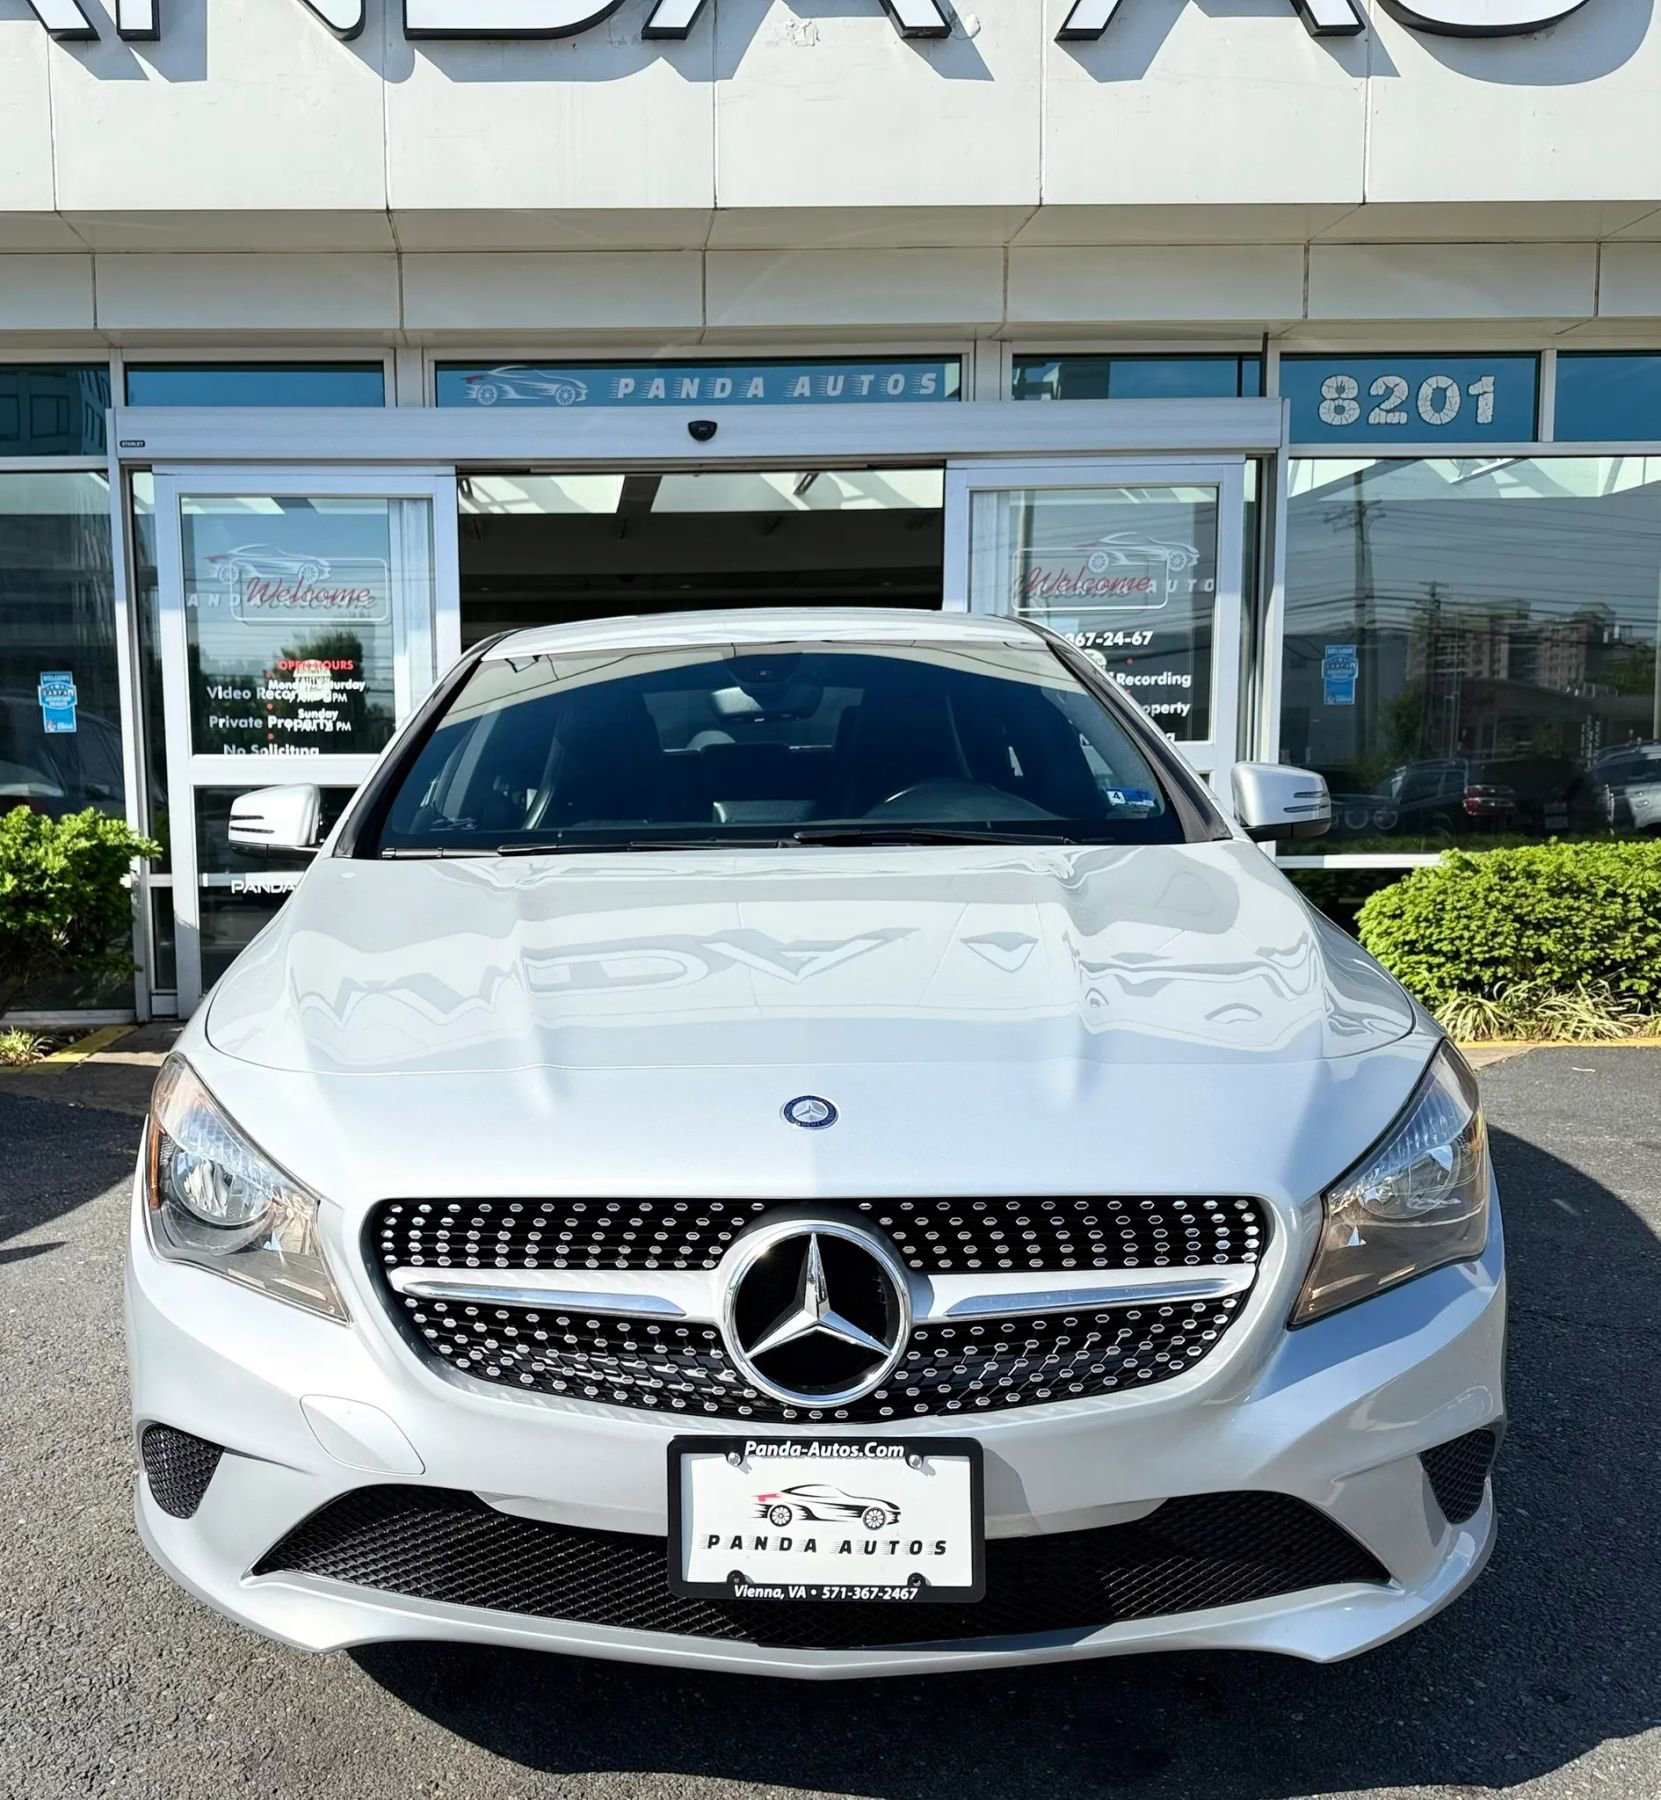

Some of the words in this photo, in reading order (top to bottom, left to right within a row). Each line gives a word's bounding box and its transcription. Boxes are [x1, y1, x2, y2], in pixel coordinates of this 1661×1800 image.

[615, 377, 765, 399] PANDA
[791, 373, 937, 397] AUTOS
[1318, 375, 1496, 426] 8201
[1026, 565, 1152, 592] Welcome
[1145, 578, 1215, 593] AUTO
[246, 575, 371, 604] Welcome
[1116, 672, 1192, 688] Recording
[206, 686, 251, 700] Video
[298, 708, 339, 721] Sunday
[1141, 702, 1192, 717] operty
[209, 715, 263, 729] Private
[223, 744, 246, 755] No
[744, 1440, 905, 1458] Panda-Autos.Com
[706, 1534, 818, 1553] PANDA
[838, 1540, 947, 1556] AUTOS
[733, 1584, 785, 1600] Vienna,
[789, 1586, 807, 1599] VA
[821, 1586, 919, 1601] 571-367-2467
